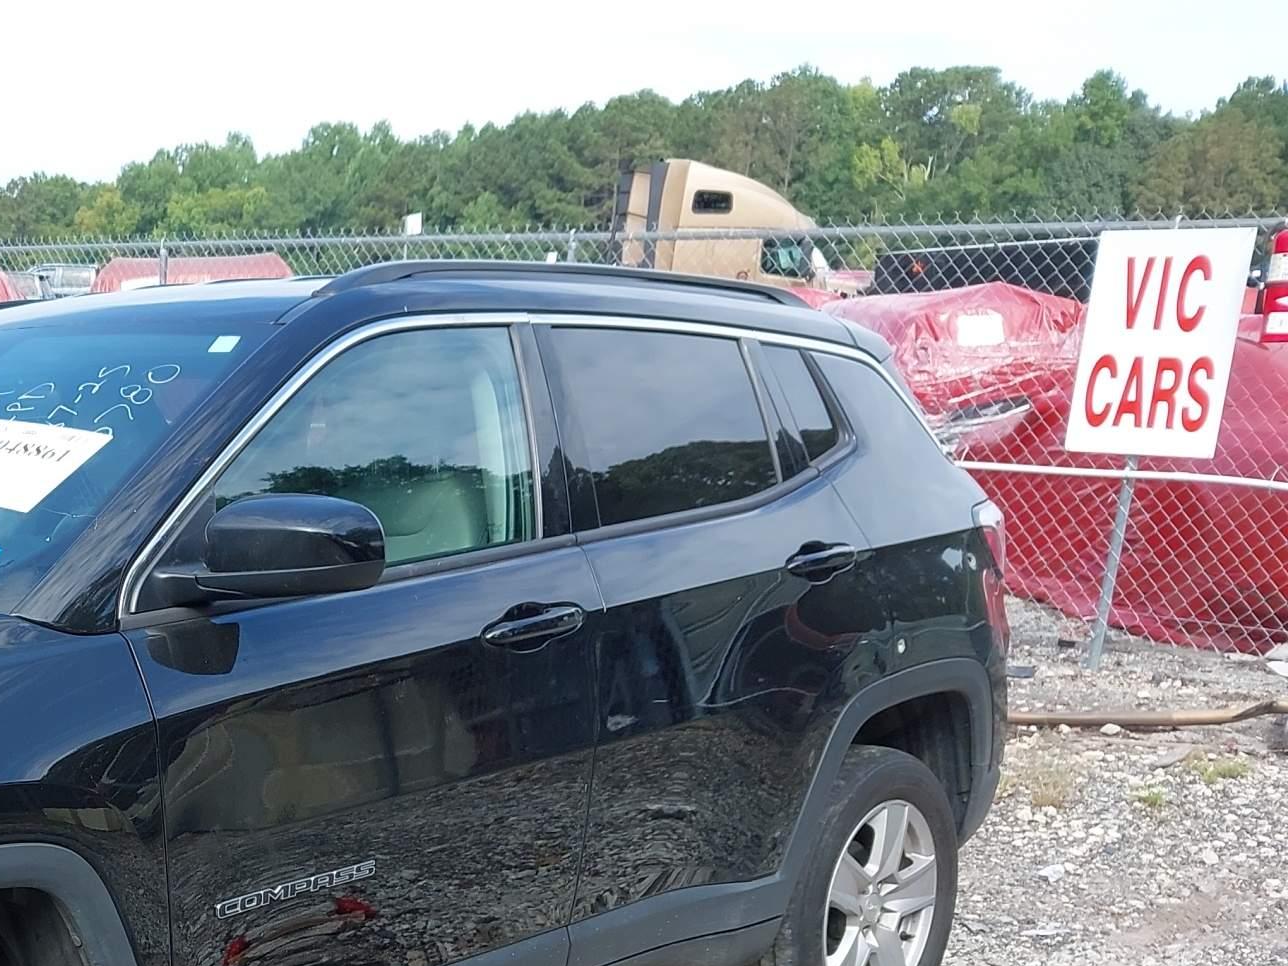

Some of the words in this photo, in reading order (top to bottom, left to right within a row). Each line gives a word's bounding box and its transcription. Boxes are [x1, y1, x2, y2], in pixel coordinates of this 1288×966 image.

[1126, 254, 1212, 333] VIC
[6, 382, 55, 421] PD
[1085, 354, 1215, 433] CARS
[215, 859, 376, 919] COMPASS
